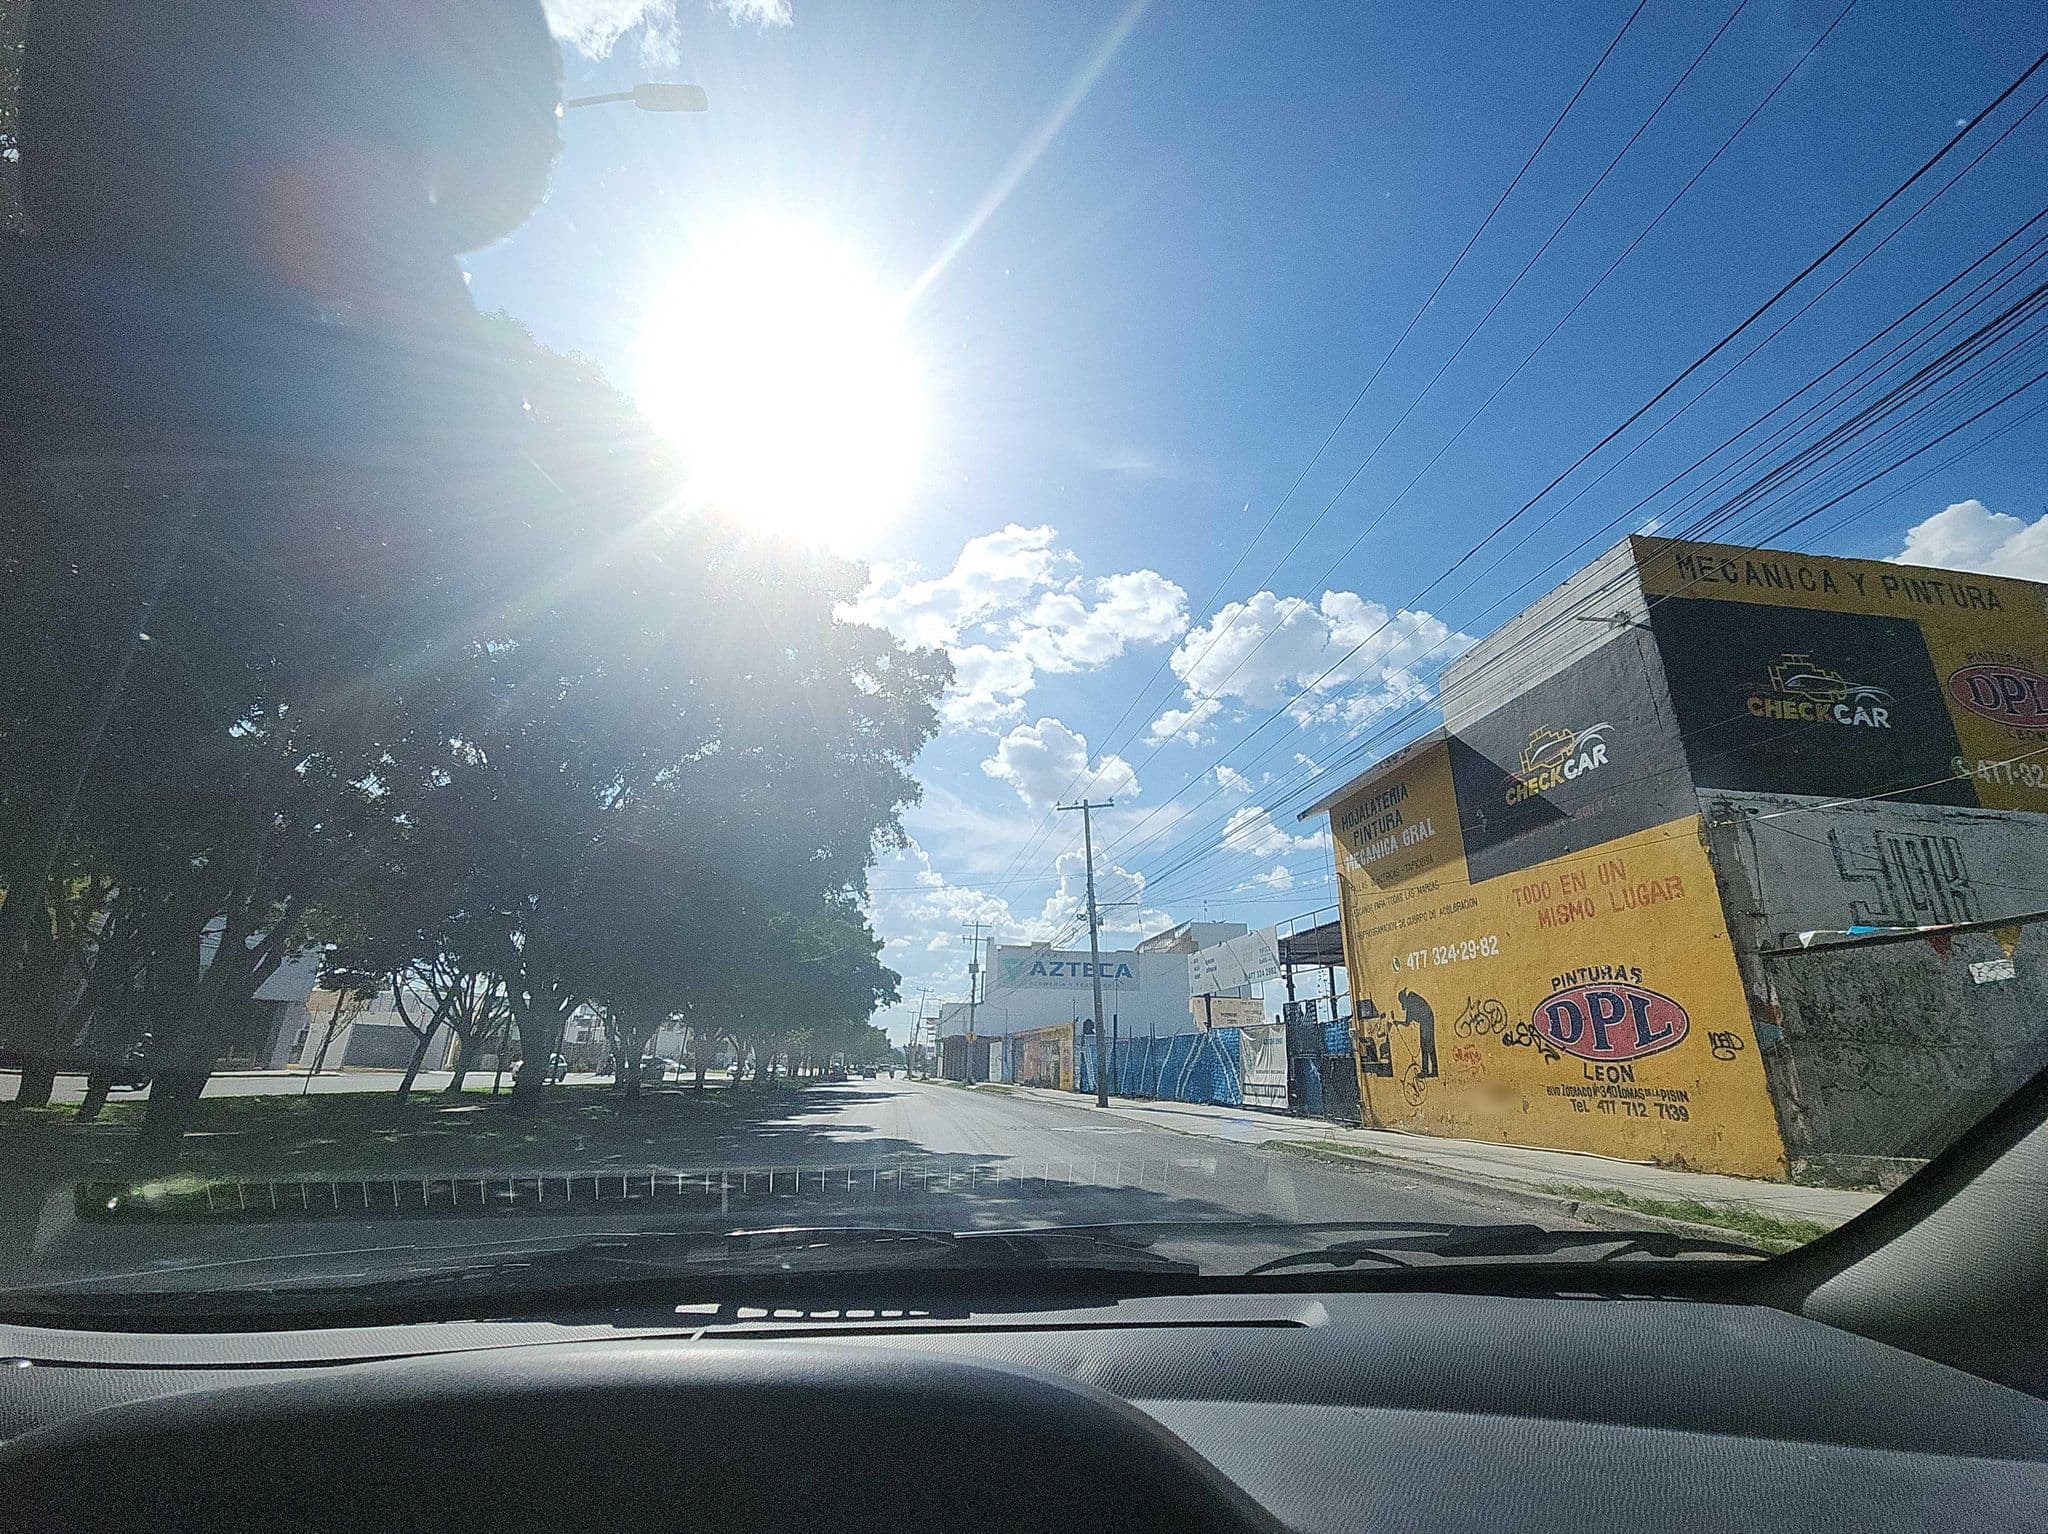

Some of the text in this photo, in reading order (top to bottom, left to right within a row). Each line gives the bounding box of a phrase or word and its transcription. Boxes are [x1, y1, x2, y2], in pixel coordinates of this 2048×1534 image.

[1675, 553, 2004, 611] MECANICA Y PINTURA
[1964, 673, 2048, 715] DPL
[1341, 782, 1409, 832] HOJALATERIA
[1345, 818, 1436, 873] MECANICA GRAL
[1353, 810, 1403, 846] PINTURA
[1512, 858, 1627, 907] TODO EN UN
[1538, 875, 1685, 930] MISMO LUGAR
[1028, 960, 1133, 979] AZTECA
[1406, 949, 1428, 971] 477
[1551, 965, 1643, 992] PINTURAS
[1545, 990, 1674, 1052] DPL
[1561, 1084, 1592, 1097] ZODIACO
[1600, 1085, 1617, 1098] 340
[1617, 1084, 1645, 1100] LOMAS
[1584, 1063, 1635, 1083] LEON
[1597, 1099, 1616, 1115] 477
[1620, 1101, 1649, 1118] 712
[1654, 1102, 1690, 1122] 7139
